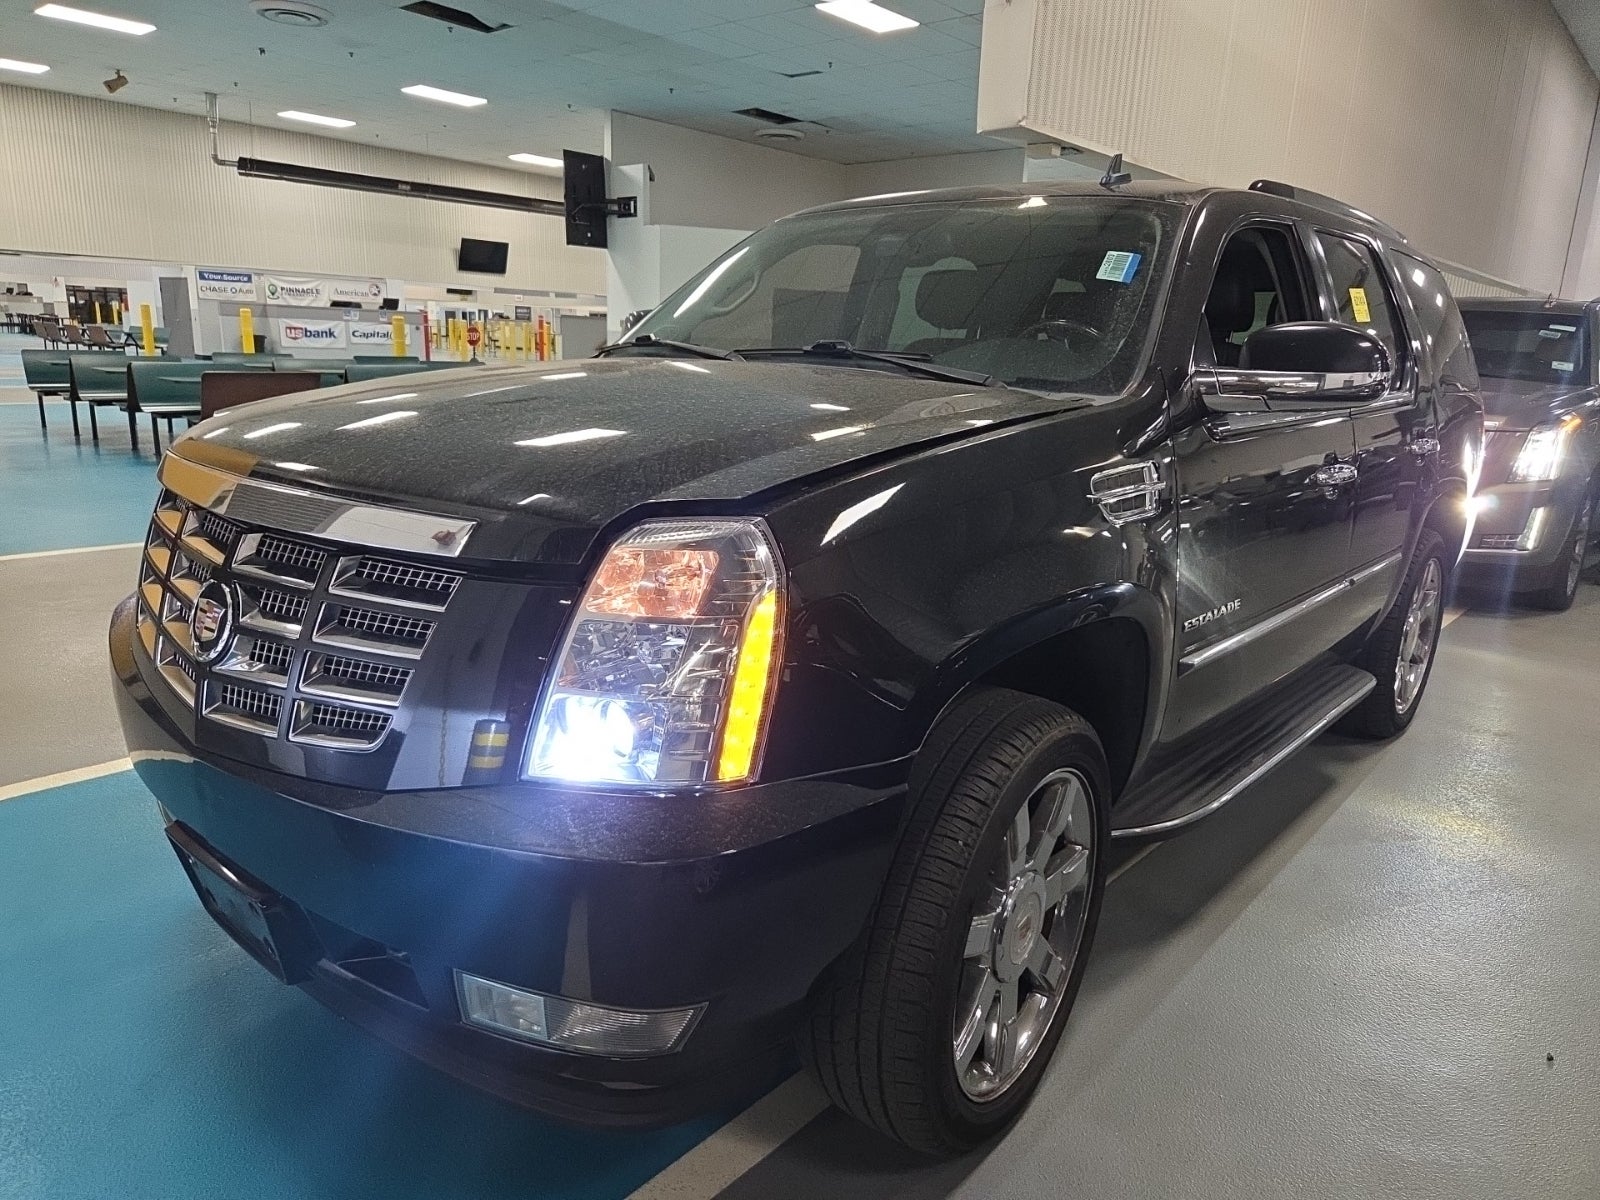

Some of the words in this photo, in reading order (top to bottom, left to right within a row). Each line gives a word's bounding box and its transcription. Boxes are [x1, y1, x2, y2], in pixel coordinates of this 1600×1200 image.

[203, 272, 221, 280] Your
[223, 273, 249, 282] Source
[200, 285, 230, 294] CHASE
[280, 286, 321, 295] PINNACLE
[334, 287, 369, 297] American
[351, 329, 389, 339] Capital
[467, 332, 480, 340] STOP
